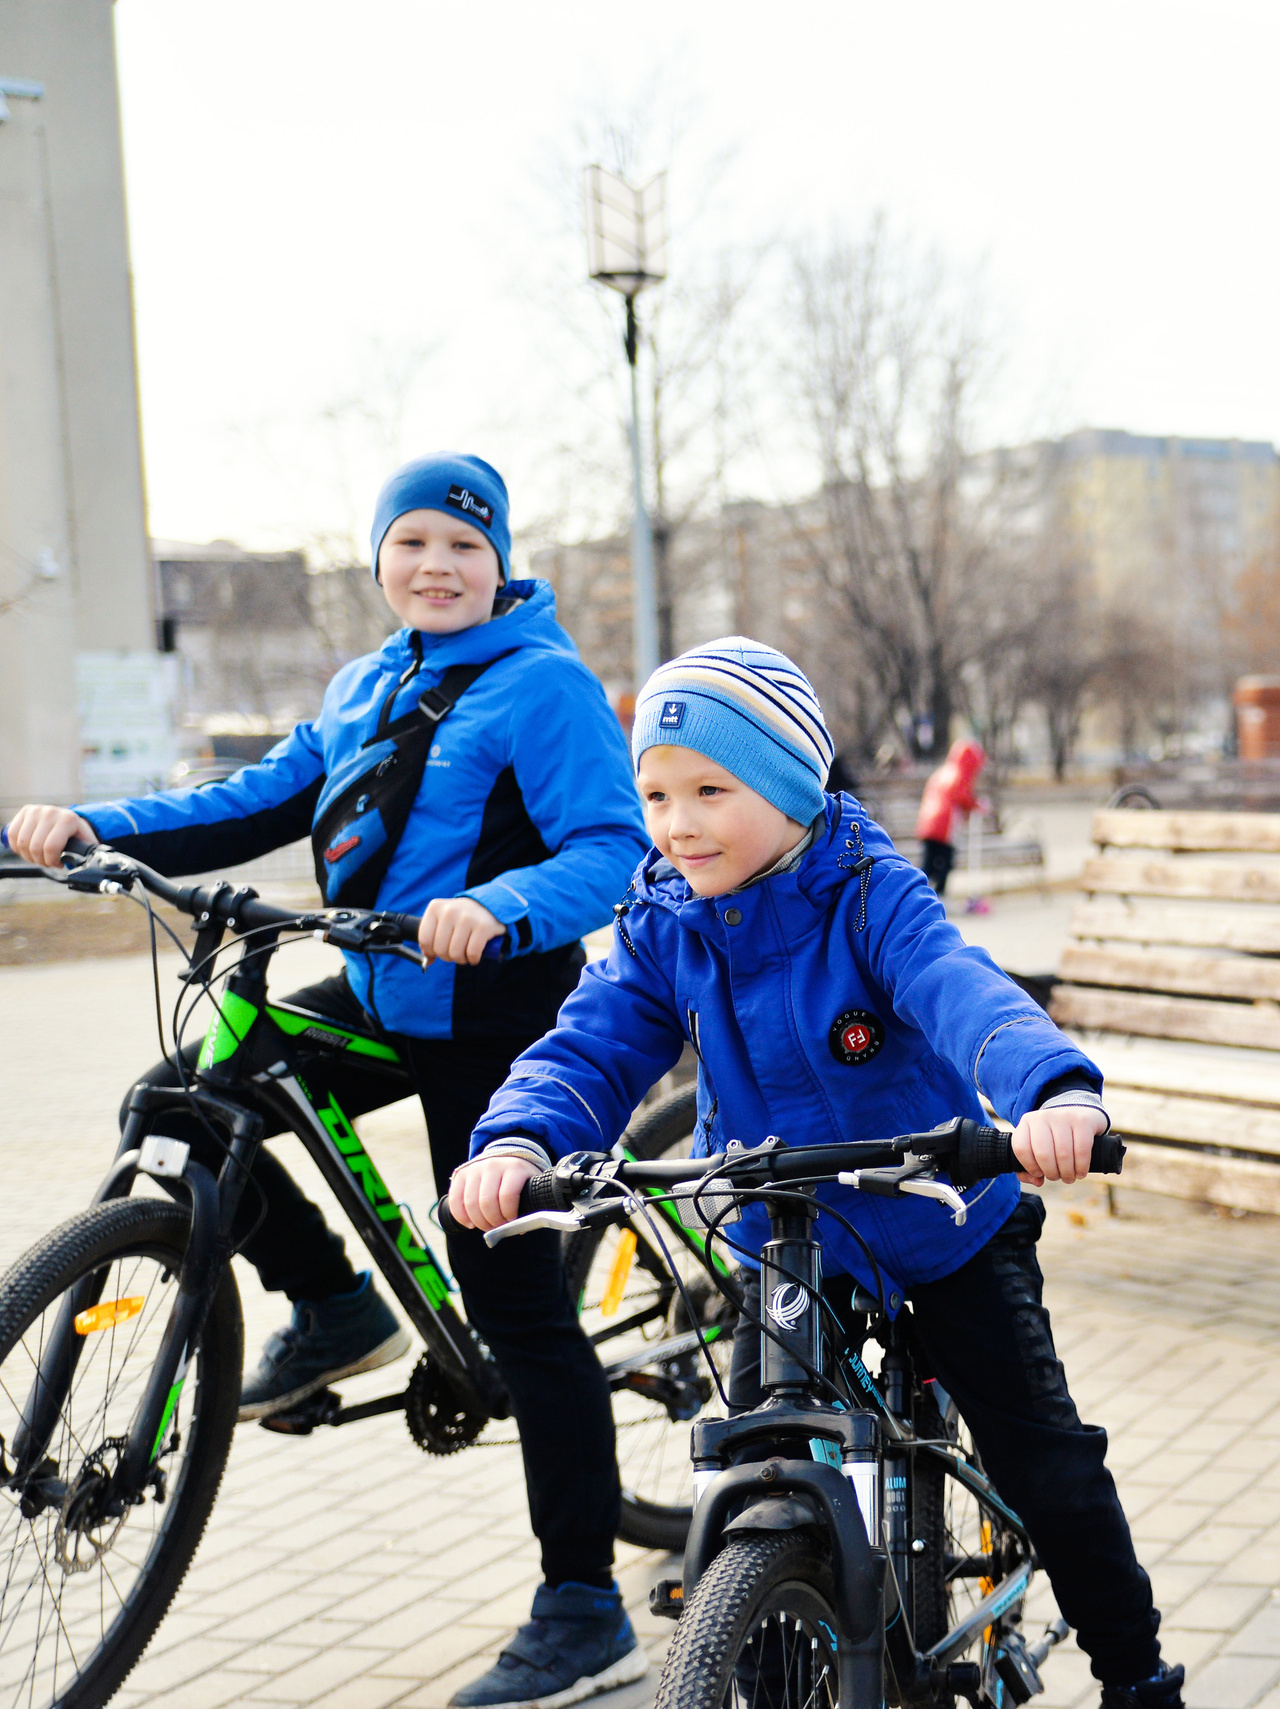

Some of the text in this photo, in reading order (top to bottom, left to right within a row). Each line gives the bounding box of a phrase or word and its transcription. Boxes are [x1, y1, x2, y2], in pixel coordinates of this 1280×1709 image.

[832, 1011, 867, 1032] VOGUE
[317, 1089, 454, 1312] DRIVE
[885, 1476, 907, 1490] ALUM
